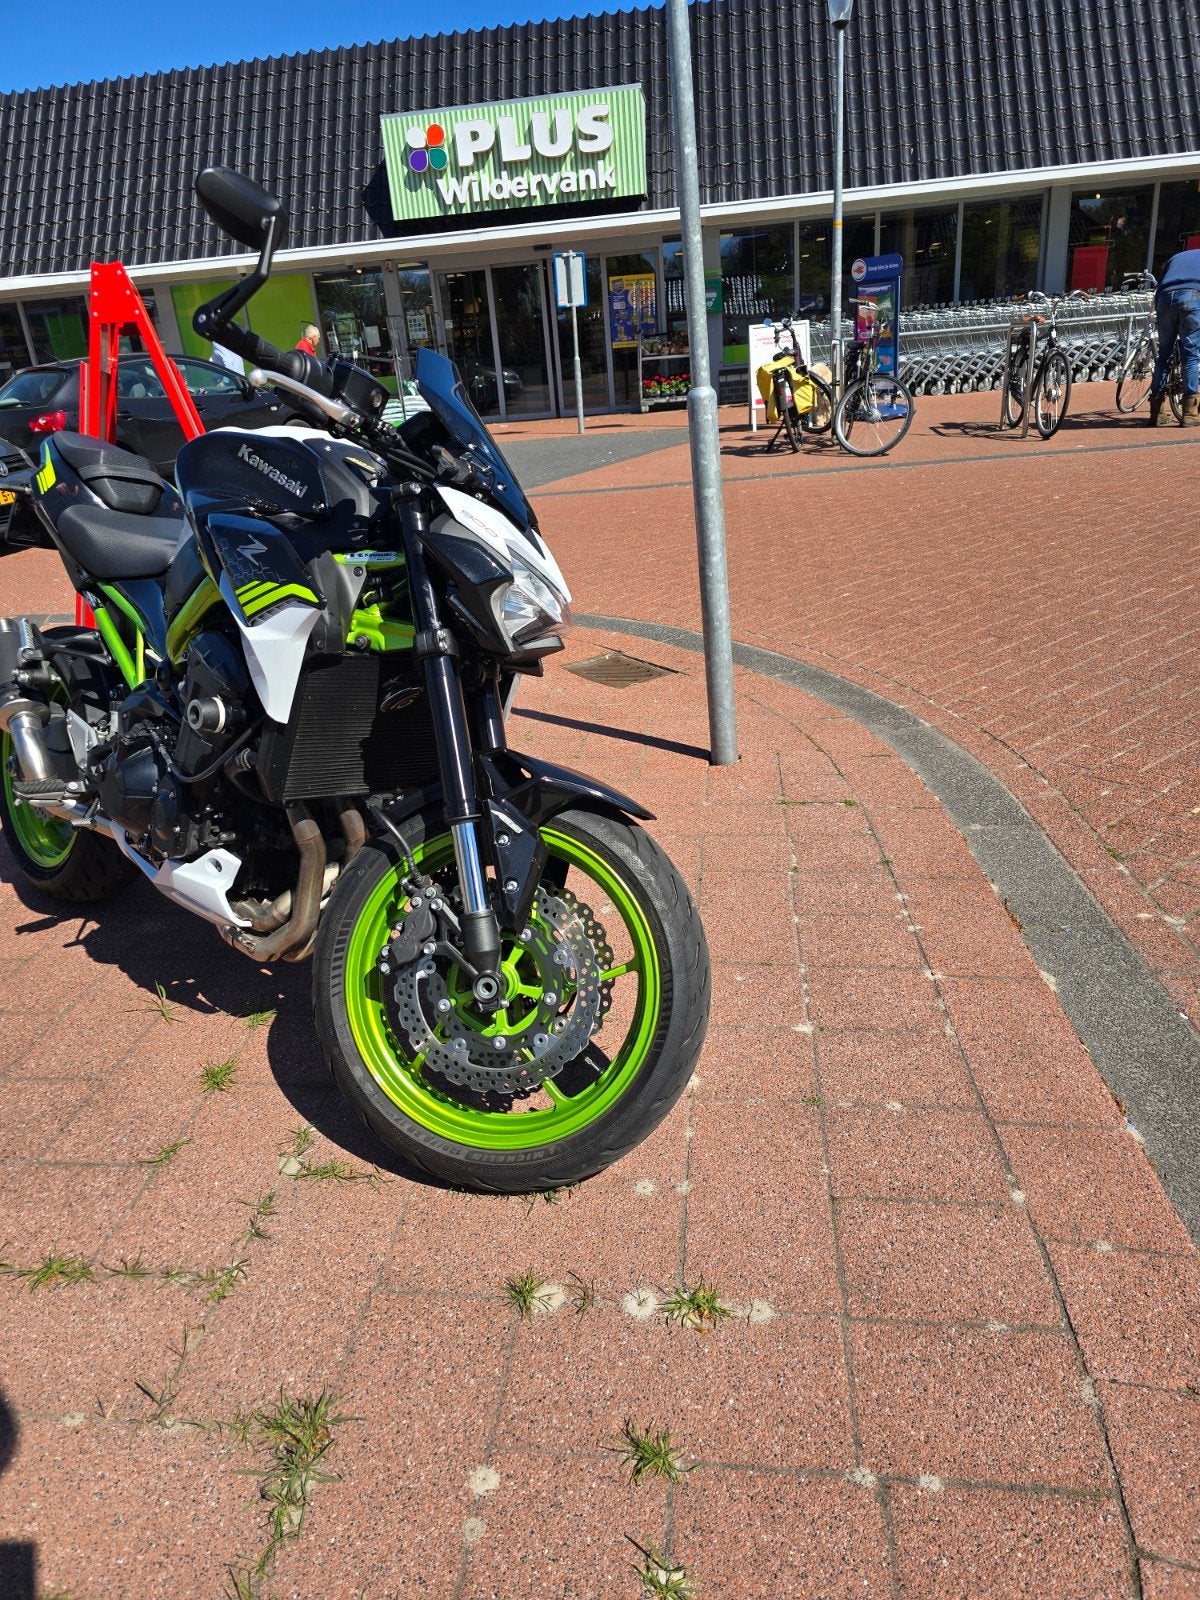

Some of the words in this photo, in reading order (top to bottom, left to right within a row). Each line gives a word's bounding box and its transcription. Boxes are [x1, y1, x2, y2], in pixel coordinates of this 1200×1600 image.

[454, 104, 615, 167] PLUS
[436, 160, 616, 206] Wildervank
[236, 443, 309, 498] Kawasaki
[460, 508, 499, 539] 900
[471, 1150, 545, 1162] MICHELIN
